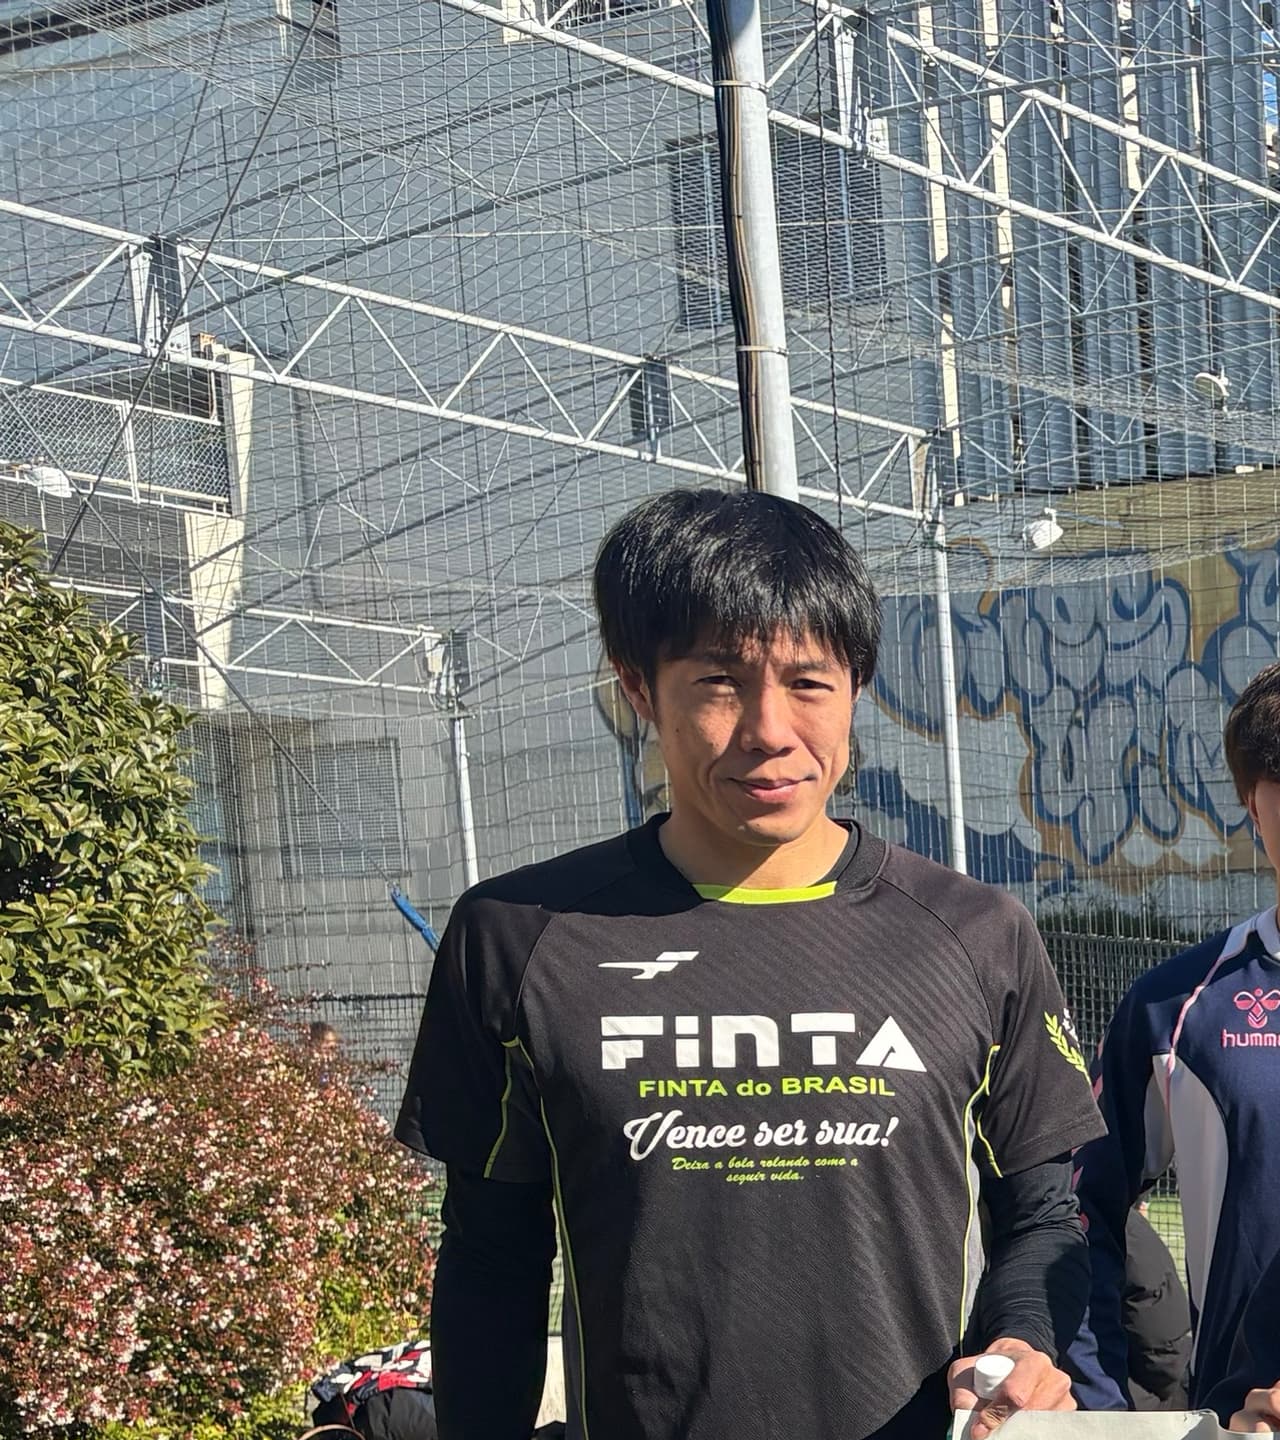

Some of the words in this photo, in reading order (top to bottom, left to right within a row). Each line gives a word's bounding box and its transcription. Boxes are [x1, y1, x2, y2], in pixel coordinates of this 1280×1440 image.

[639, 1078, 727, 1098] FINTA
[735, 1079, 772, 1097] do
[780, 1075, 897, 1097] BRASIL
[623, 1109, 747, 1162] Vence
[754, 1121, 808, 1149] ser
[815, 1116, 900, 1149] sua!
[671, 1156, 710, 1171] Deixa
[714, 1160, 724, 1170] a
[728, 1155, 755, 1169] bola
[760, 1155, 811, 1169] rolando
[814, 1156, 847, 1168] como
[850, 1157, 859, 1167] a
[726, 1171, 766, 1186] seguir
